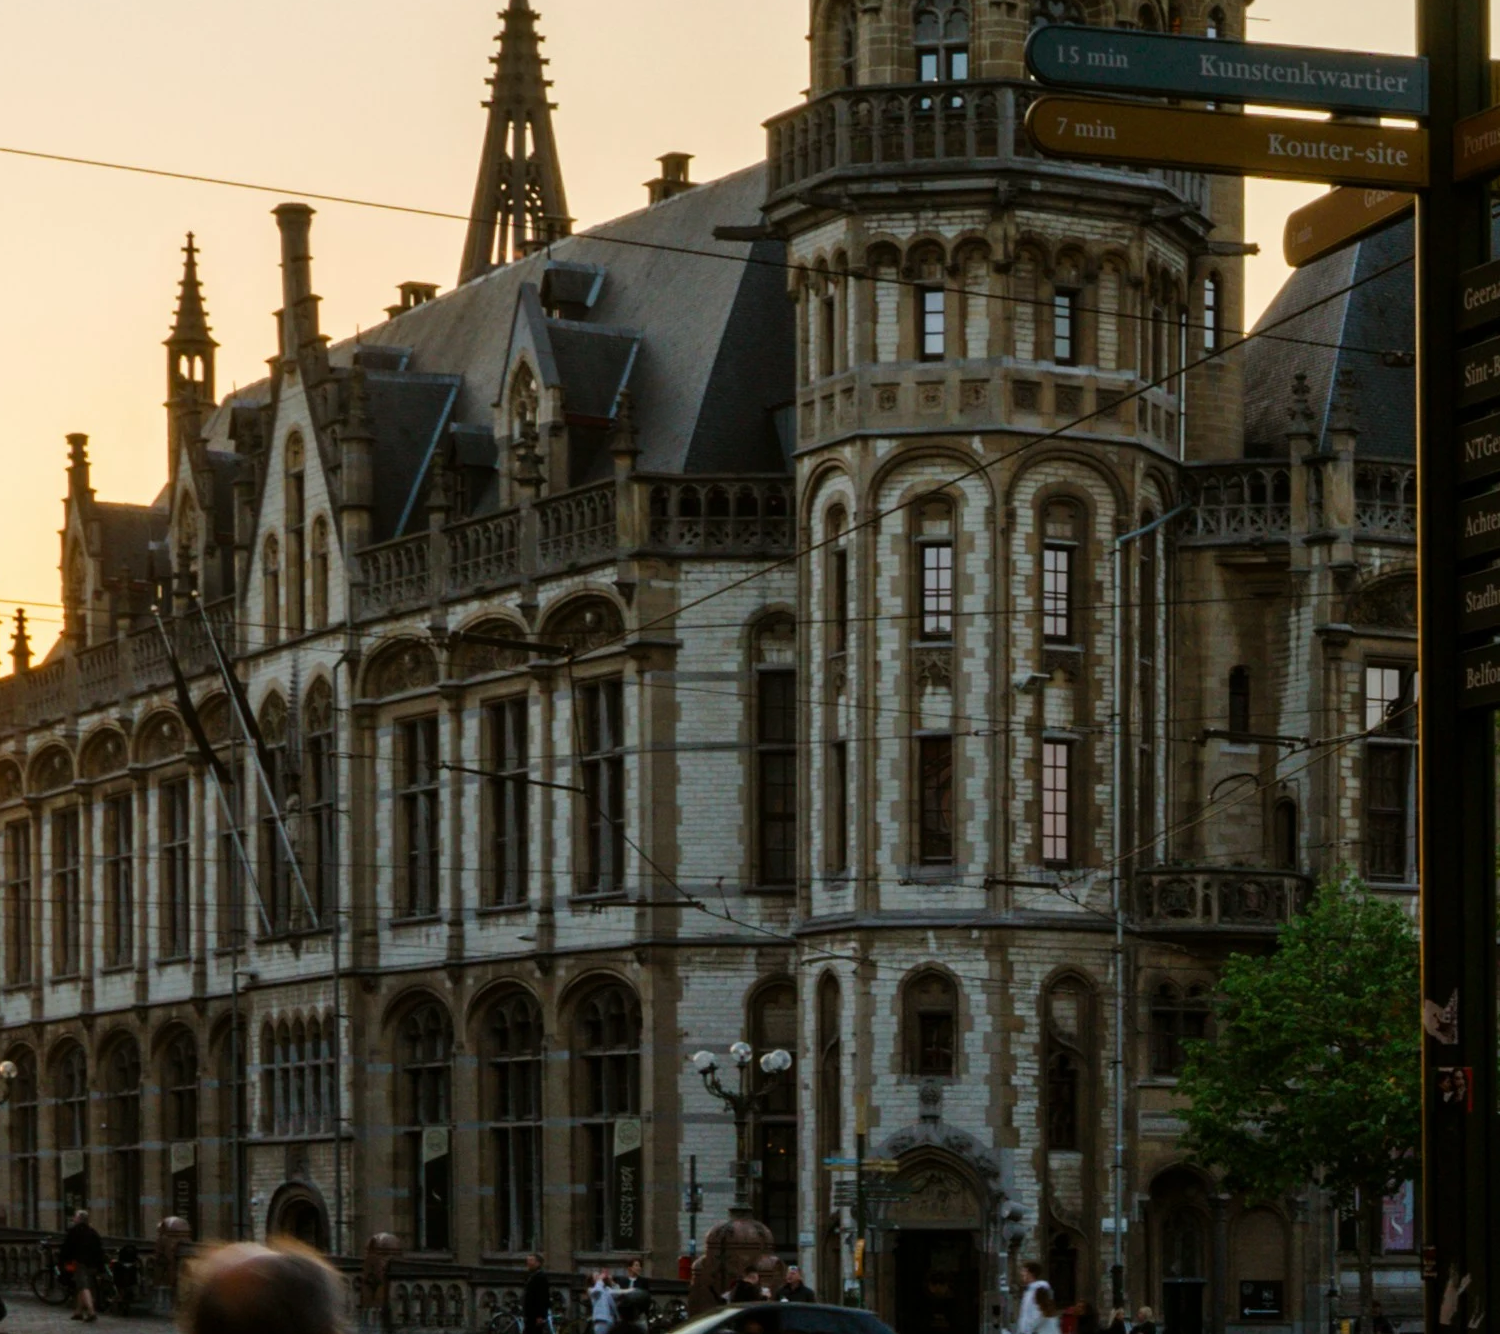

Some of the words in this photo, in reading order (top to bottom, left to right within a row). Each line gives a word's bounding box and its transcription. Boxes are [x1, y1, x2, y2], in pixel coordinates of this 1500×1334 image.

[1057, 46, 1080, 66] 15
[1087, 49, 1129, 69] min
[1200, 54, 1408, 94] Kunstenkwartier
[1057, 117, 1068, 136] 7
[1074, 119, 1117, 140] min
[1268, 133, 1409, 167] Kouter-site
